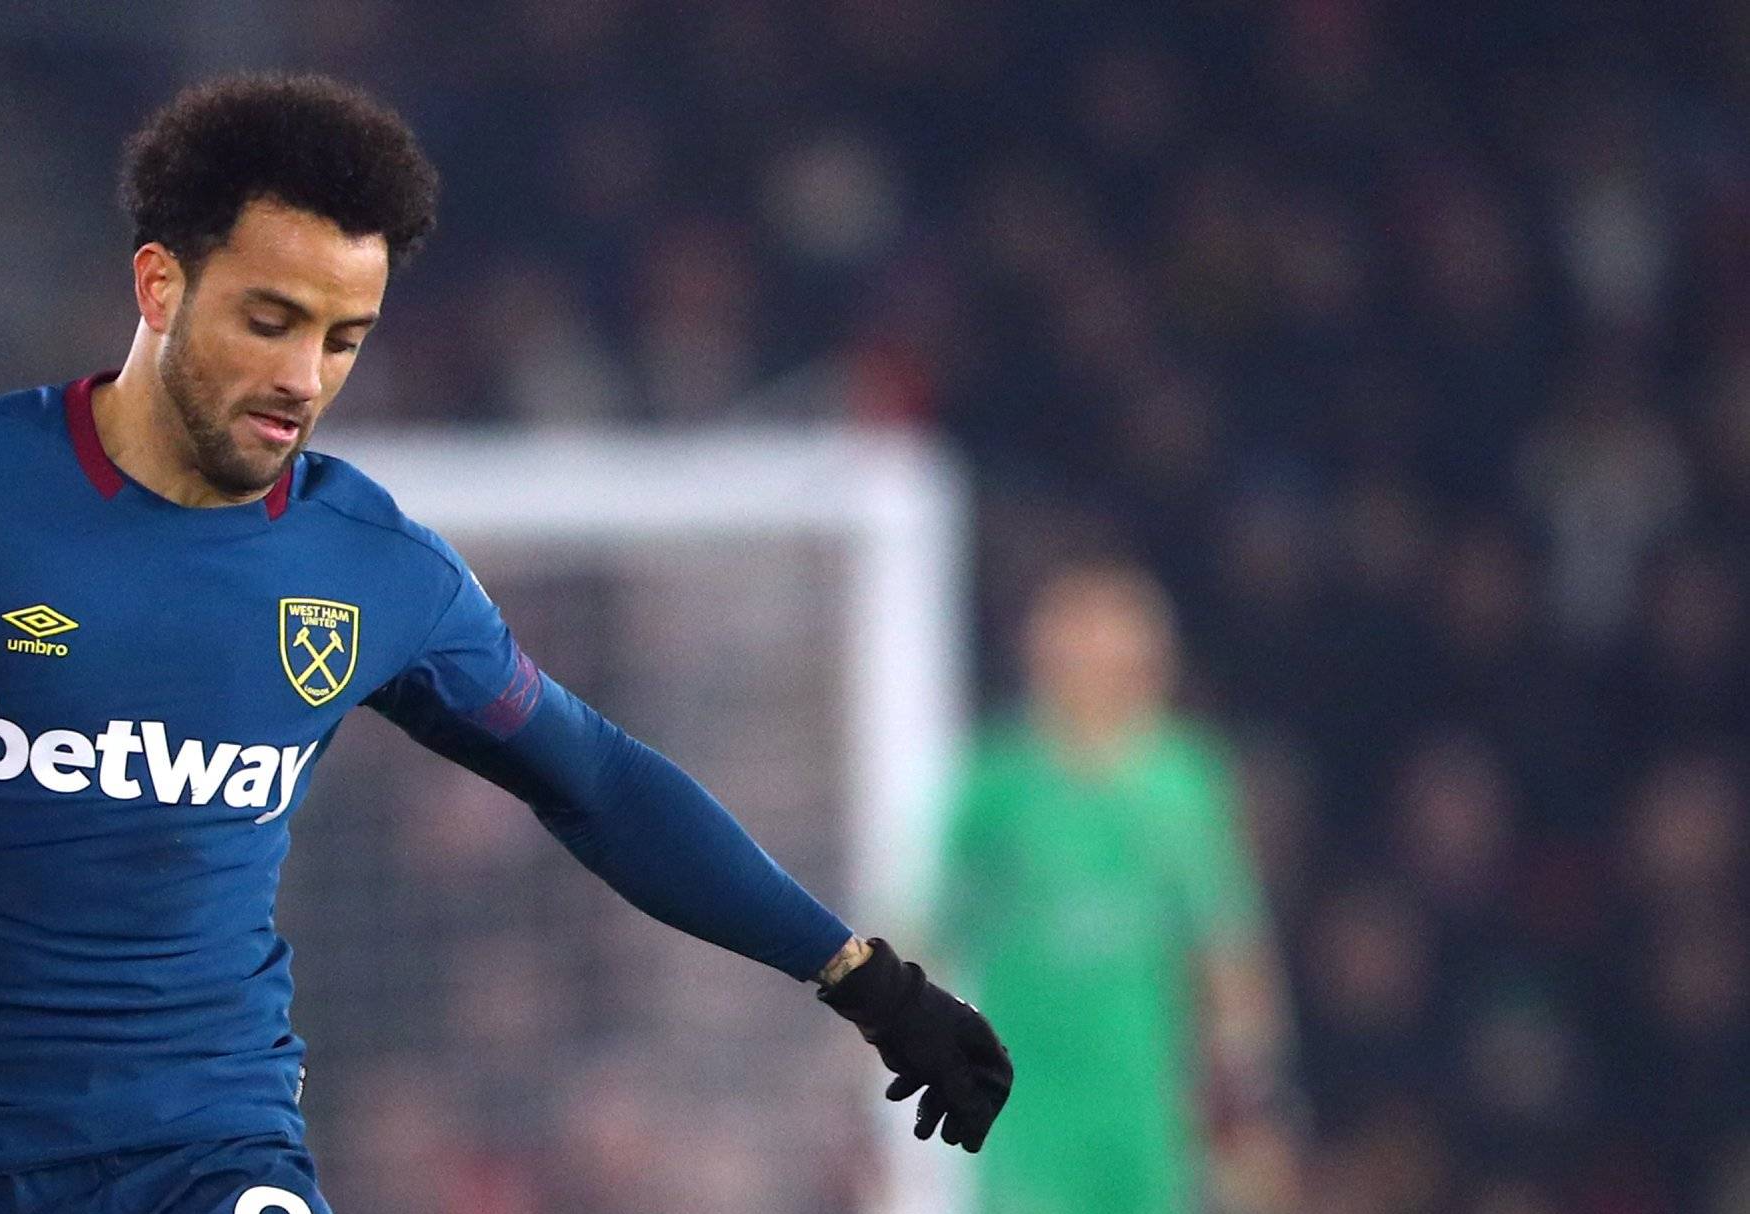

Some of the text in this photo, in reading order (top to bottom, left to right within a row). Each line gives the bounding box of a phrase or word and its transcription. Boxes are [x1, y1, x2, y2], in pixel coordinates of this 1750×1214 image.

[289, 604, 350, 623] WEST HAM
[301, 617, 337, 628] UNITED
[7, 638, 68, 656] umbro
